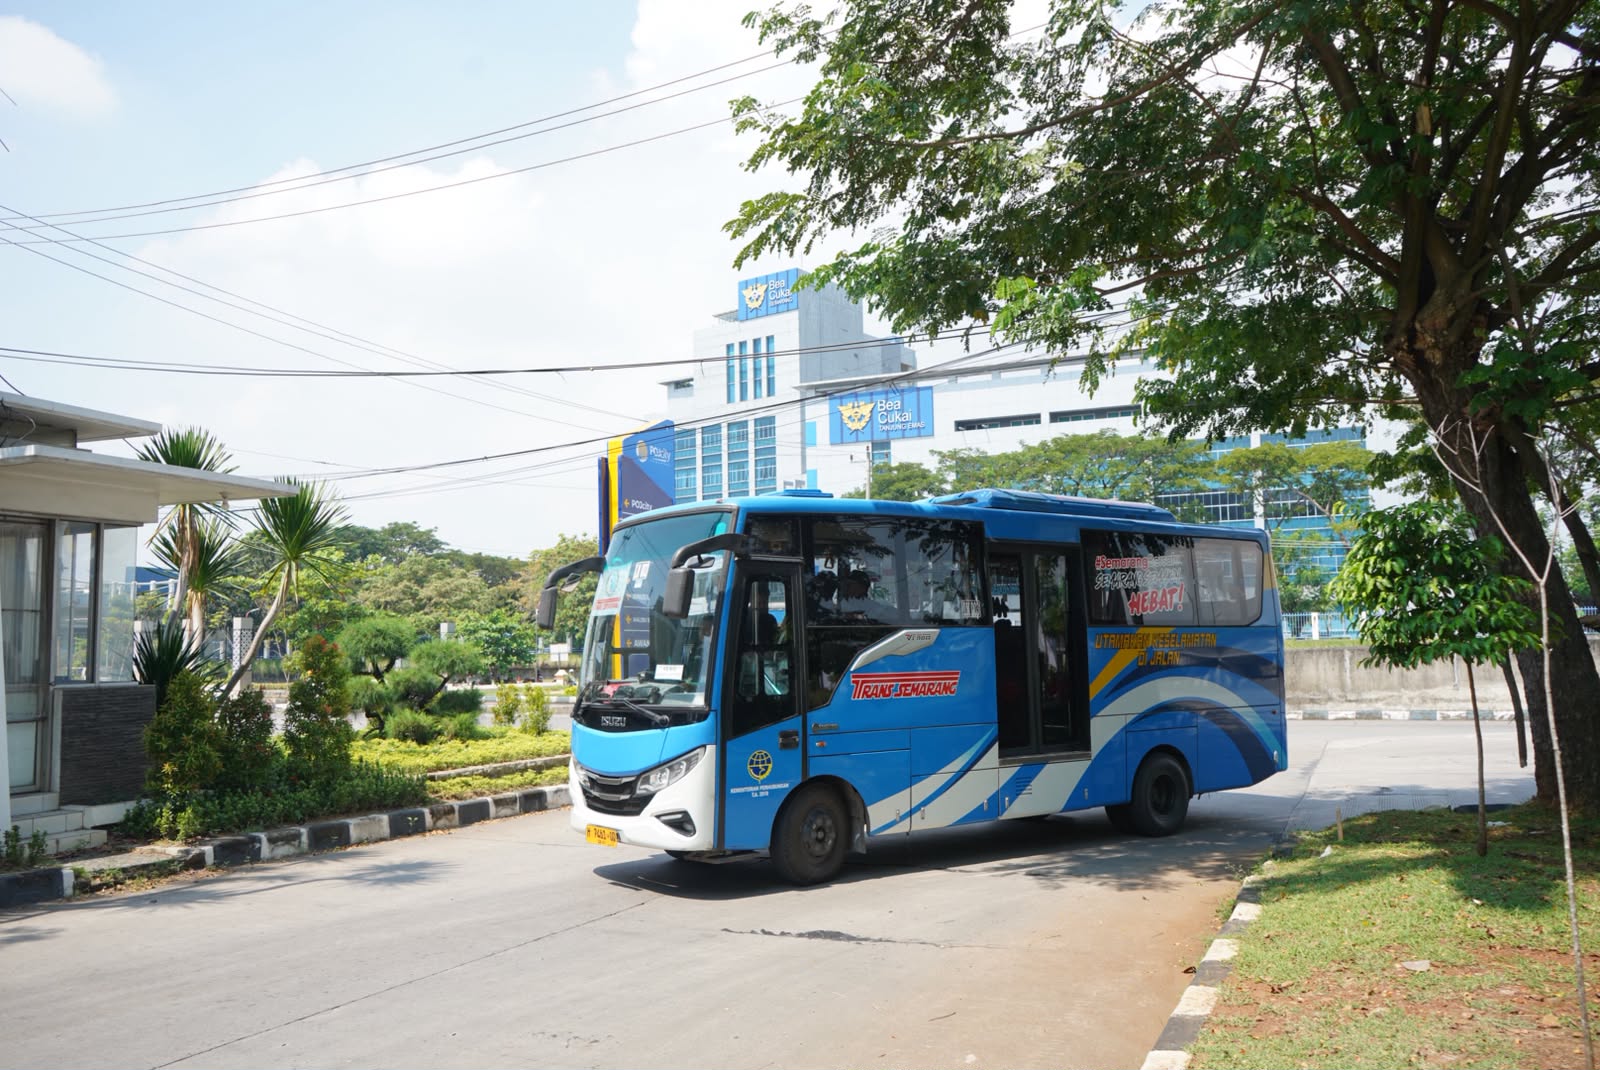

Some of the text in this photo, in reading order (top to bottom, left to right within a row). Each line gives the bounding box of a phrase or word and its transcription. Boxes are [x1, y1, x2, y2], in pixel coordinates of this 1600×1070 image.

[769, 280, 785, 289] Bea
[769, 288, 793, 300] Cuka
[877, 400, 901, 411] Bea
[878, 409, 912, 423] Cukai
[879, 421, 925, 432] TANJUNG EMAS
[1128, 582, 1184, 616] HEBAT!
[1138, 650, 1180, 666] DI JALAN
[851, 679, 959, 700] TRANS SEMARANG
